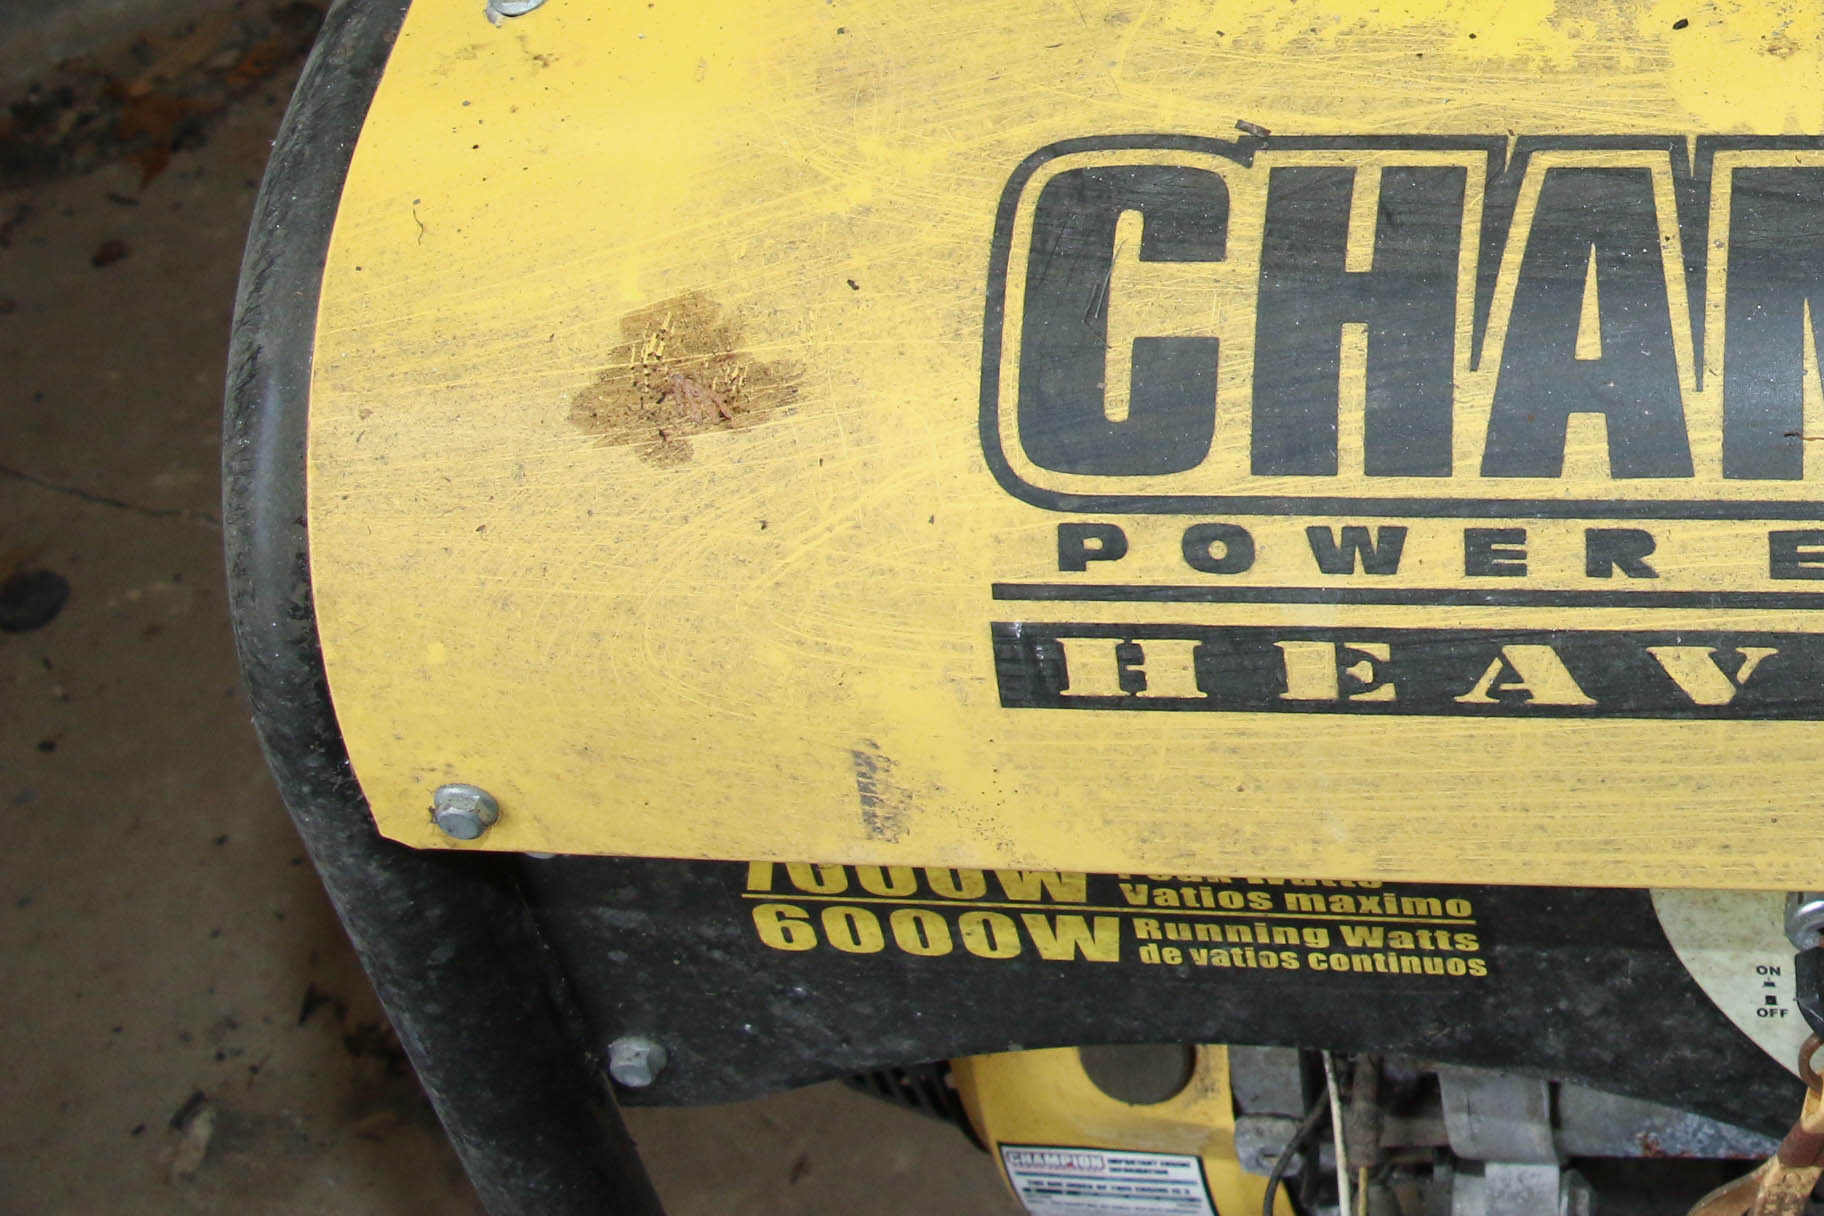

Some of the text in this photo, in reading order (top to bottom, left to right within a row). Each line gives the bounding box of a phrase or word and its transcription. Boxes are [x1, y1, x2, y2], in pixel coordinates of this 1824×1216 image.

[1056, 523, 1660, 580] POWER
[1119, 883, 1473, 918] Vatios maximo
[751, 903, 1120, 962] 6000W
[1132, 917, 1481, 952] Running Watts
[1138, 943, 1488, 977] de vatios continuos
[1755, 965, 1782, 976] ON
[1755, 1007, 1790, 1019] OFF
